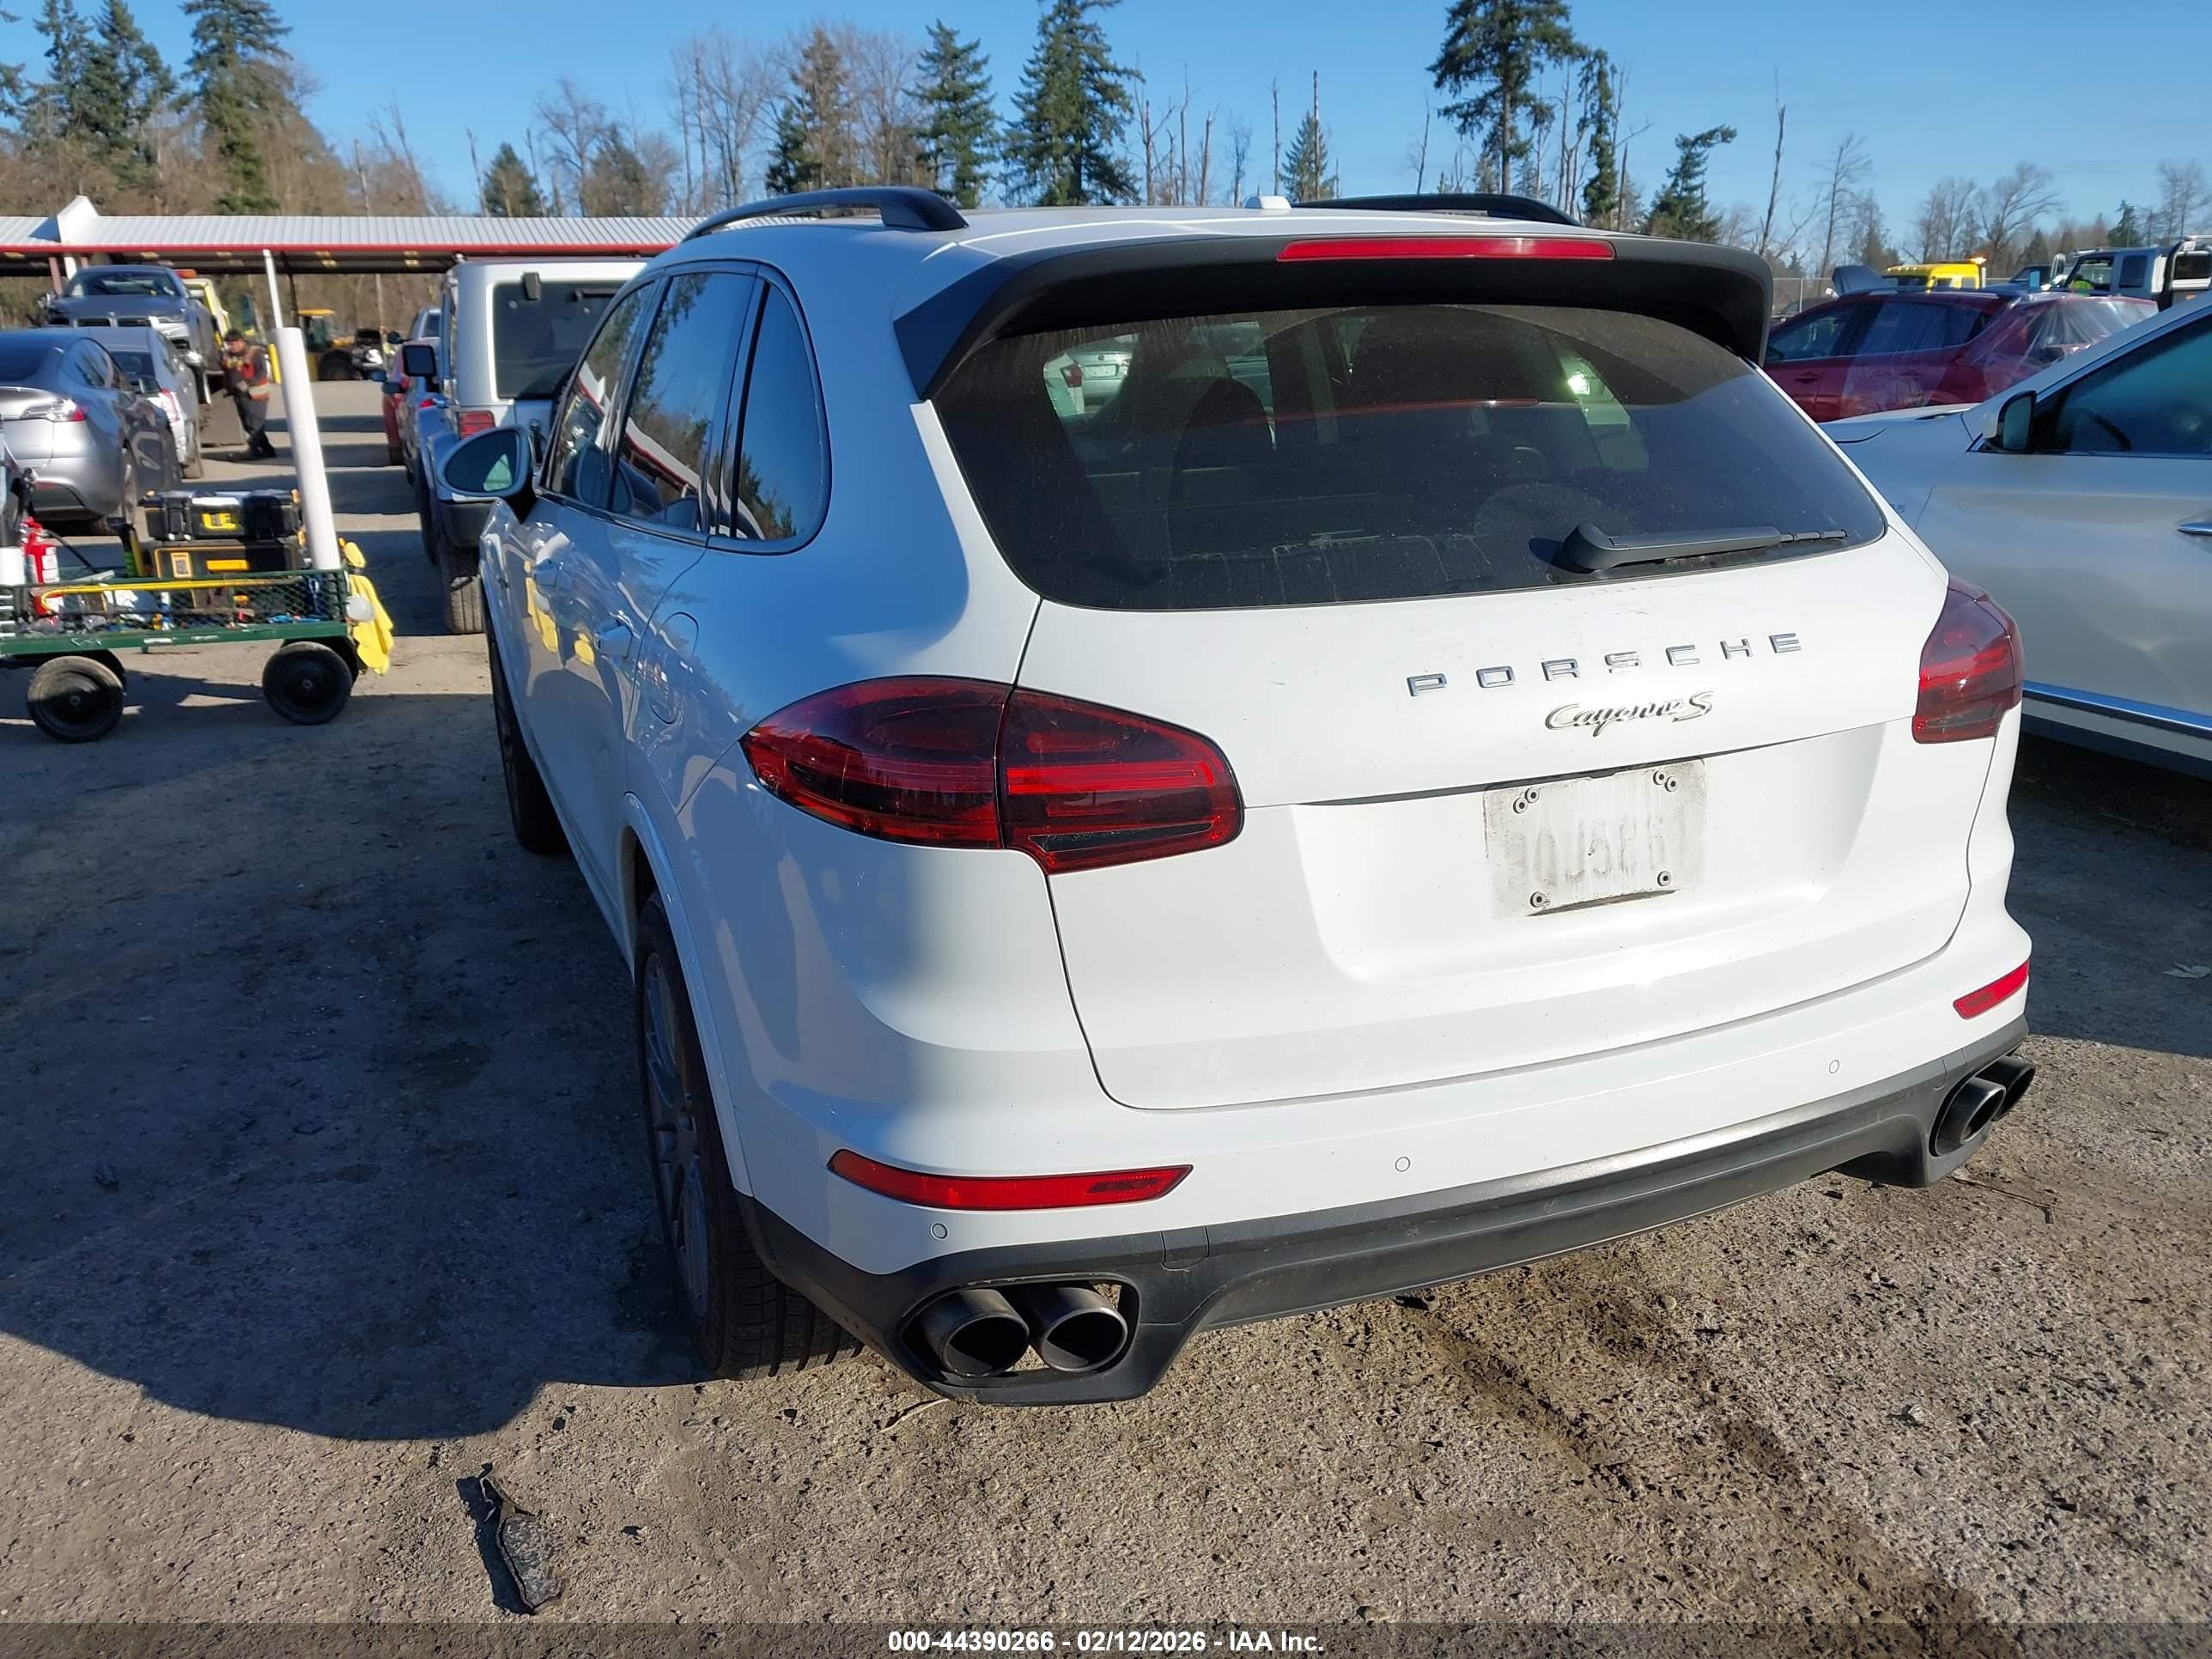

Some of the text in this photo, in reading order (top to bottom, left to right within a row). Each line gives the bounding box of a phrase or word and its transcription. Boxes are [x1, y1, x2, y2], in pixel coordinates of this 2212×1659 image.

[1407, 632, 1802, 697] PORSCHE
[1545, 690, 1716, 738] Cayenne S
